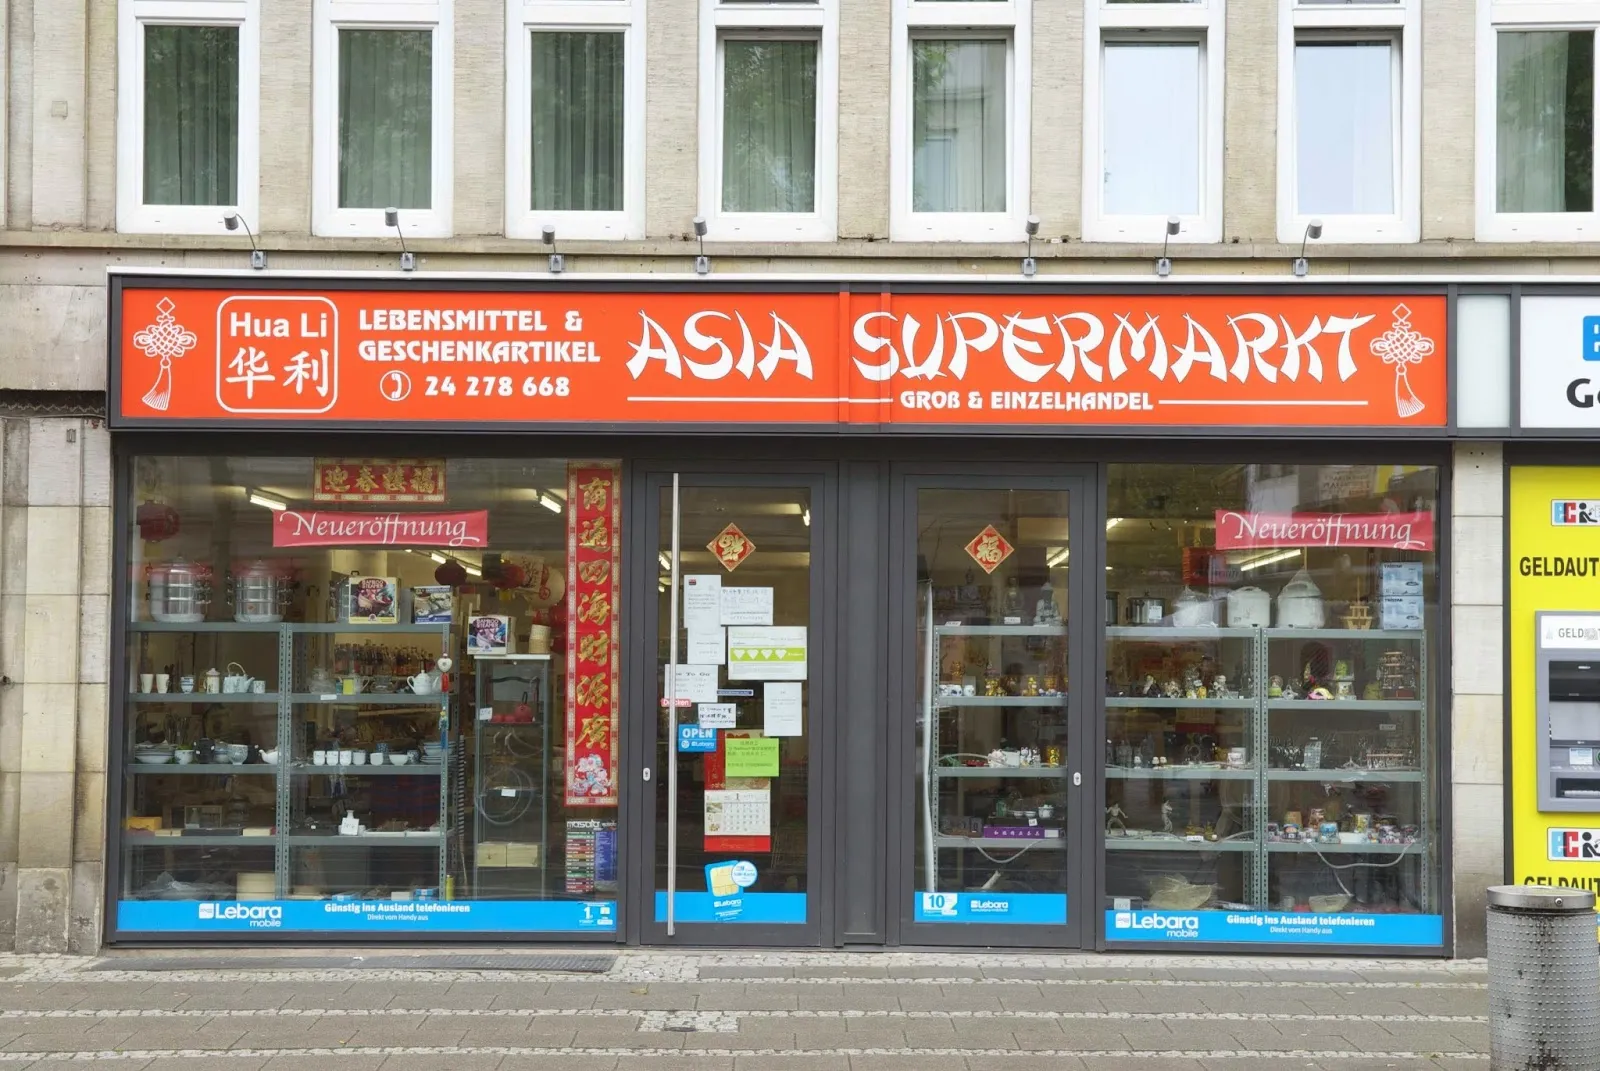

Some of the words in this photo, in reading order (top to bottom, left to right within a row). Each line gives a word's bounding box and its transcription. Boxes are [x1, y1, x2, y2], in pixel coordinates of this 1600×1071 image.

[230, 312, 290, 338] Hua
[300, 312, 327, 338] Li
[359, 309, 548, 331] LEBENSMITTEL
[564, 310, 583, 332] &
[358, 340, 601, 365] GESCHENKARTIKEL
[625, 309, 813, 381] ASIA
[852, 310, 1376, 384] SUPERMARKT
[225, 346, 330, 400] 华利
[425, 375, 457, 397] 24
[465, 376, 513, 397] 278
[522, 376, 570, 397] 668
[967, 391, 983, 409] &
[990, 390, 1155, 412] EINZELHANDEL
[279, 511, 480, 547] Neueröffnung
[1221, 511, 1426, 549] Neueröffnung
[976, 534, 1003, 563] 福
[682, 727, 714, 739] OPEN
[215, 903, 282, 919] Lebara
[324, 902, 361, 914] Günstig
[361, 902, 377, 912] ins
[377, 902, 415, 912] Ausland
[415, 902, 471, 912] telefonieren
[928, 894, 945, 909] 10
[978, 900, 1009, 909] Lebara
[249, 918, 282, 928] mobile
[1132, 912, 1199, 929] Lebara
[1226, 914, 1264, 927] Günstig
[1264, 915, 1279, 925] ins
[1280, 915, 1318, 926] Ausland
[1319, 915, 1376, 927] telefonieren
[1166, 928, 1199, 938] mobile
